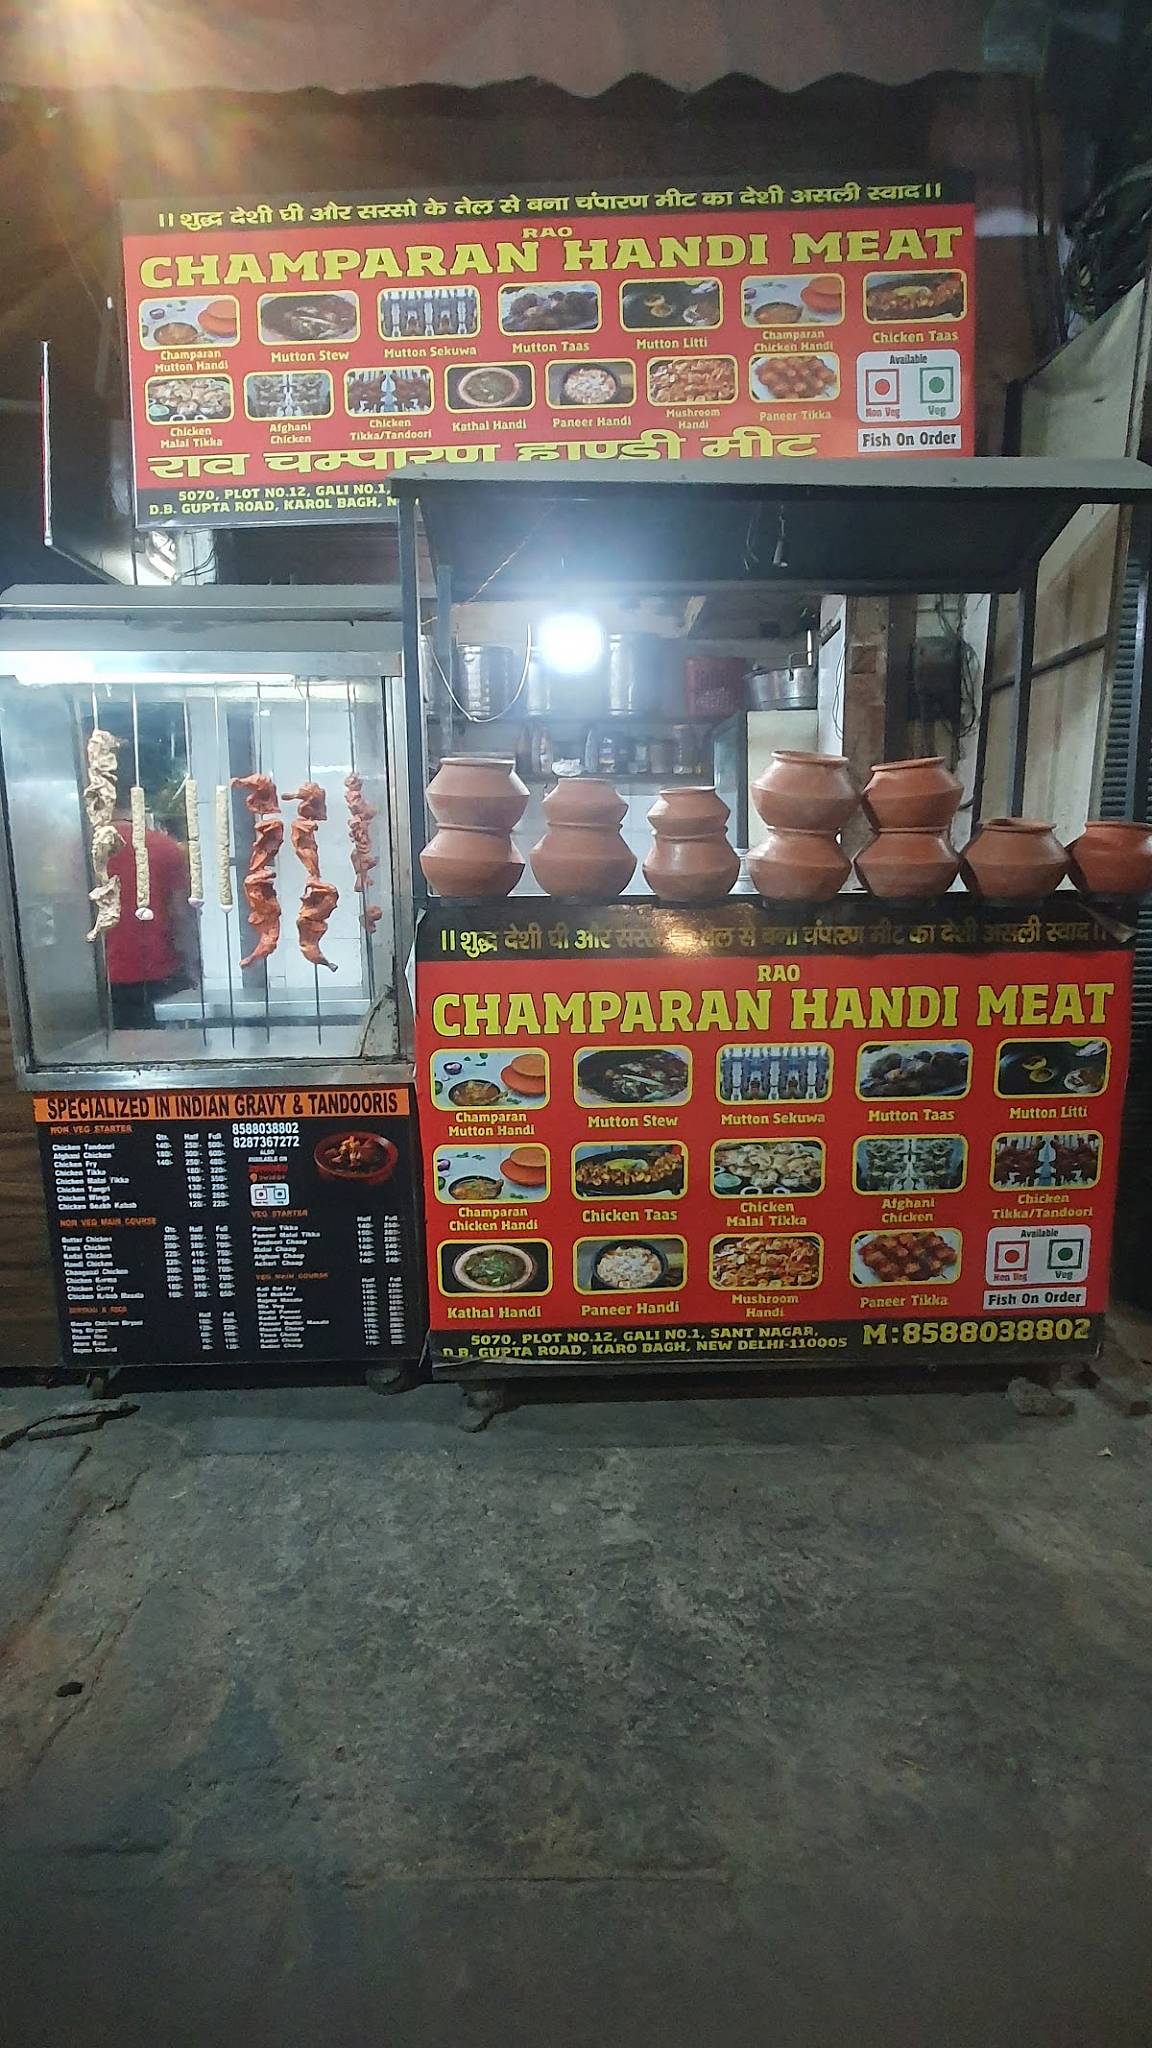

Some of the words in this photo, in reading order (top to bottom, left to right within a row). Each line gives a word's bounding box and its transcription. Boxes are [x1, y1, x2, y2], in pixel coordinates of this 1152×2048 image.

[229, 205, 273, 224] देशी
[423, 198, 448, 215] के
[454, 196, 494, 215] तेल
[499, 194, 521, 213] से
[526, 197, 569, 211] बना
[575, 192, 649, 210] चंपारण
[654, 188, 697, 207] मीट
[702, 192, 734, 205] का
[739, 185, 784, 204] देशी
[791, 182, 861, 203] असली
[523, 227, 572, 238] RAO
[141, 242, 540, 289] CHAMPARAN
[562, 233, 768, 270] HANDI
[792, 227, 962, 264] MEAT
[763, 331, 824, 341] Champaran
[873, 332, 924, 343] Chicken
[928, 331, 958, 341] Taas
[513, 343, 556, 353] Mutton
[561, 342, 589, 351] Taas
[637, 339, 679, 349] Mutton
[684, 337, 707, 348] Litti
[754, 343, 797, 352] Chicken
[801, 342, 833, 350] Handi
[161, 351, 221, 361] Champaran
[271, 352, 315, 362] Mutton
[320, 350, 349, 361] Stew
[385, 349, 426, 358] Mutton
[430, 346, 476, 356] Sekuwa
[890, 354, 927, 364] Available
[155, 363, 193, 372] Mutton
[196, 360, 228, 370] Handi
[666, 408, 720, 417] Mushroom
[760, 412, 797, 421] Paneer
[801, 410, 831, 420] Tikka
[928, 405, 946, 417] Veg
[370, 419, 411, 428] Chicken
[453, 421, 489, 431] Kathal
[493, 419, 526, 430] Handi
[553, 418, 592, 427] Paneer
[597, 416, 631, 426] Handi
[679, 420, 708, 429] Handi
[171, 427, 211, 436] Chicken
[270, 423, 311, 433] Afghani
[271, 435, 311, 444] Chicken
[350, 429, 431, 440] Tikka/Tandoori
[863, 433, 891, 447] Fish
[897, 433, 914, 446] On
[920, 431, 956, 445] Order
[161, 438, 193, 449] Malai
[196, 438, 222, 447] Tikka
[148, 454, 250, 478] राव
[700, 425, 820, 457] मीट
[179, 490, 219, 501] 5070,
[225, 489, 260, 499] PLOT
[265, 487, 310, 497] NO.12,
[316, 485, 348, 496] GALI
[353, 484, 390, 494] NO.1,
[150, 504, 176, 515] D.B.
[182, 502, 230, 513] GUPTA
[235, 501, 279, 511] ROAD,
[284, 499, 332, 510] KAROL
[337, 497, 382, 508] BAGH,
[758, 965, 800, 981] RAO
[433, 990, 771, 1036] CHAMPARAN
[791, 986, 958, 1029] HANDI
[977, 983, 1114, 1025] MEAT
[47, 1096, 150, 1119] SPECIALIZED
[155, 1095, 170, 1117] IN
[176, 1094, 229, 1117] INDIAN
[234, 1094, 286, 1116] GRAVY
[293, 1094, 303, 1114] &
[308, 1093, 397, 1114] TANDOORIS
[1010, 1108, 1056, 1118] Mutton
[1061, 1106, 1087, 1118] Litti
[456, 1112, 526, 1124] Champaran
[588, 1116, 638, 1127] Mutton
[644, 1115, 677, 1126] Stew
[722, 1114, 769, 1124] Mutton
[773, 1112, 825, 1124] Sekuwa
[868, 1110, 918, 1121] Mutton
[923, 1109, 954, 1120] Taas
[232, 1122, 299, 1135] 8588038802
[449, 1126, 493, 1136] Mutton
[498, 1125, 534, 1135] Handi
[234, 1136, 299, 1148] 8287367272
[882, 1198, 934, 1210] Afghani
[1018, 1194, 1069, 1204] Chicken
[459, 1207, 527, 1219] Champaran
[741, 1202, 794, 1212] Chicken
[992, 1207, 1093, 1219] Tikka/Tandoori
[583, 1209, 639, 1222] Chicken
[644, 1209, 677, 1220] Taas
[727, 1216, 763, 1226] Malai
[769, 1215, 806, 1225] Tikka
[882, 1212, 933, 1223] Chicken
[450, 1221, 497, 1231] Chicken
[502, 1220, 537, 1230] Handi
[1021, 1228, 1058, 1238] Available
[1055, 1271, 1073, 1280] Veg
[732, 1294, 798, 1304] Mushroom
[860, 1297, 905, 1308] Paneer
[911, 1294, 948, 1305] Tikka
[989, 1294, 1016, 1305] Fish
[1022, 1293, 1039, 1304] On
[1045, 1291, 1081, 1303] Order
[448, 1307, 494, 1318] Kathal
[499, 1306, 540, 1318] Handi
[582, 1305, 632, 1315] Paneer
[637, 1301, 679, 1313] Handi
[746, 1308, 784, 1317] Handi
[471, 1335, 516, 1345] 5070,
[522, 1333, 562, 1343] PLOT
[567, 1332, 617, 1342] NO.12,
[623, 1331, 659, 1341] GALI
[665, 1329, 705, 1339] NO.1,
[711, 1328, 754, 1338] SANT
[759, 1327, 818, 1337] NAGAR,
[863, 1319, 1090, 1344] M:8588038802
[479, 1346, 532, 1357] GUPTA
[538, 1345, 586, 1355] ROAD,
[592, 1344, 637, 1354] KARO
[642, 1342, 690, 1353] BAGH,
[697, 1341, 732, 1351] NEW
[738, 1338, 847, 1350] DELHI-110005
